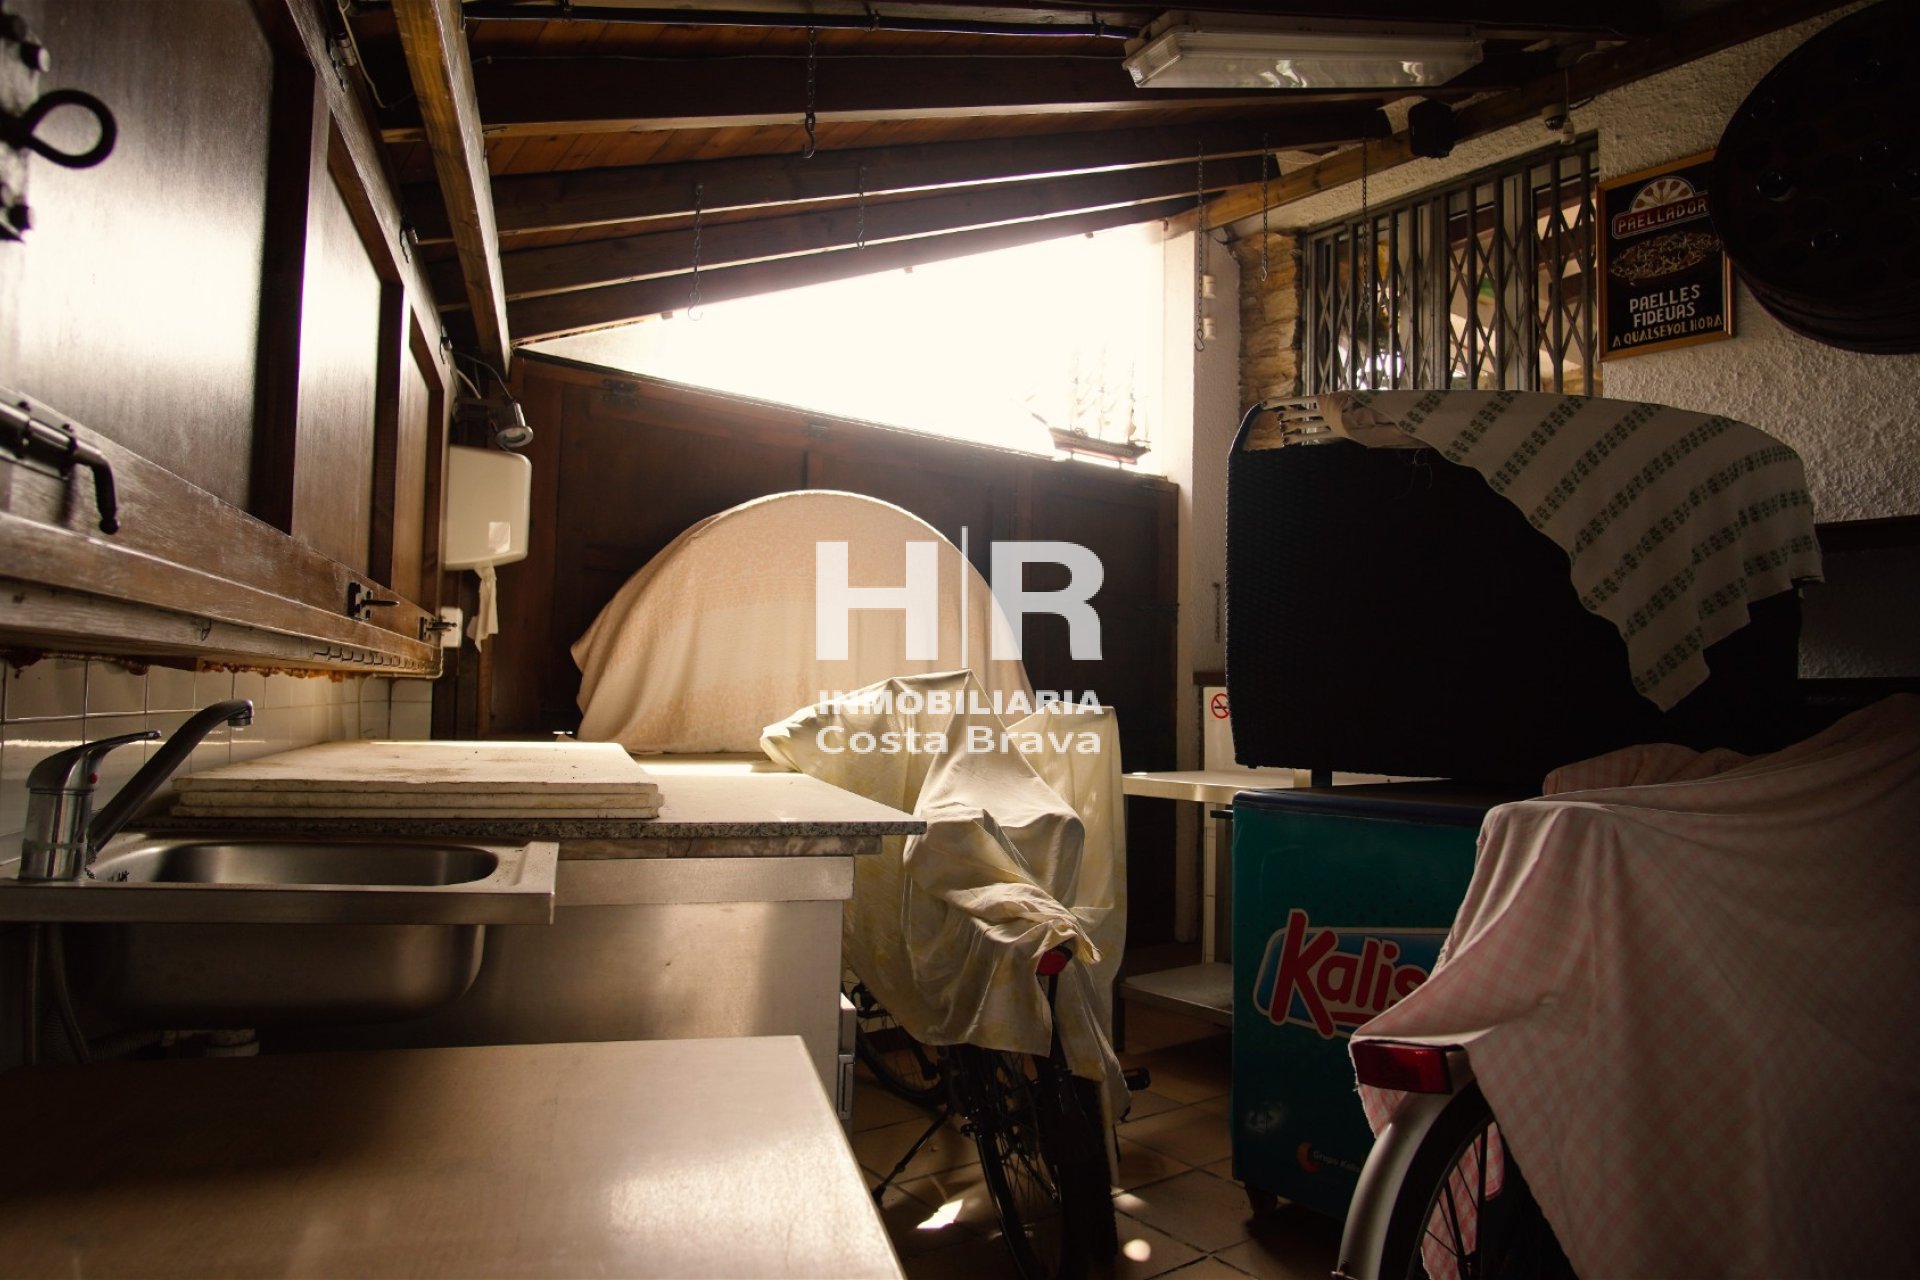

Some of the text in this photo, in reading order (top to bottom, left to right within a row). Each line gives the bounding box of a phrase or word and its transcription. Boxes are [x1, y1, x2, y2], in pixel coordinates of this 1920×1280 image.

[1618, 198, 1707, 233] PAELLADOR
[1629, 284, 1701, 313] PAELLES
[1633, 301, 1696, 328] FIDEUAS
[1612, 314, 1723, 348] A QUALSEVOL HORA
